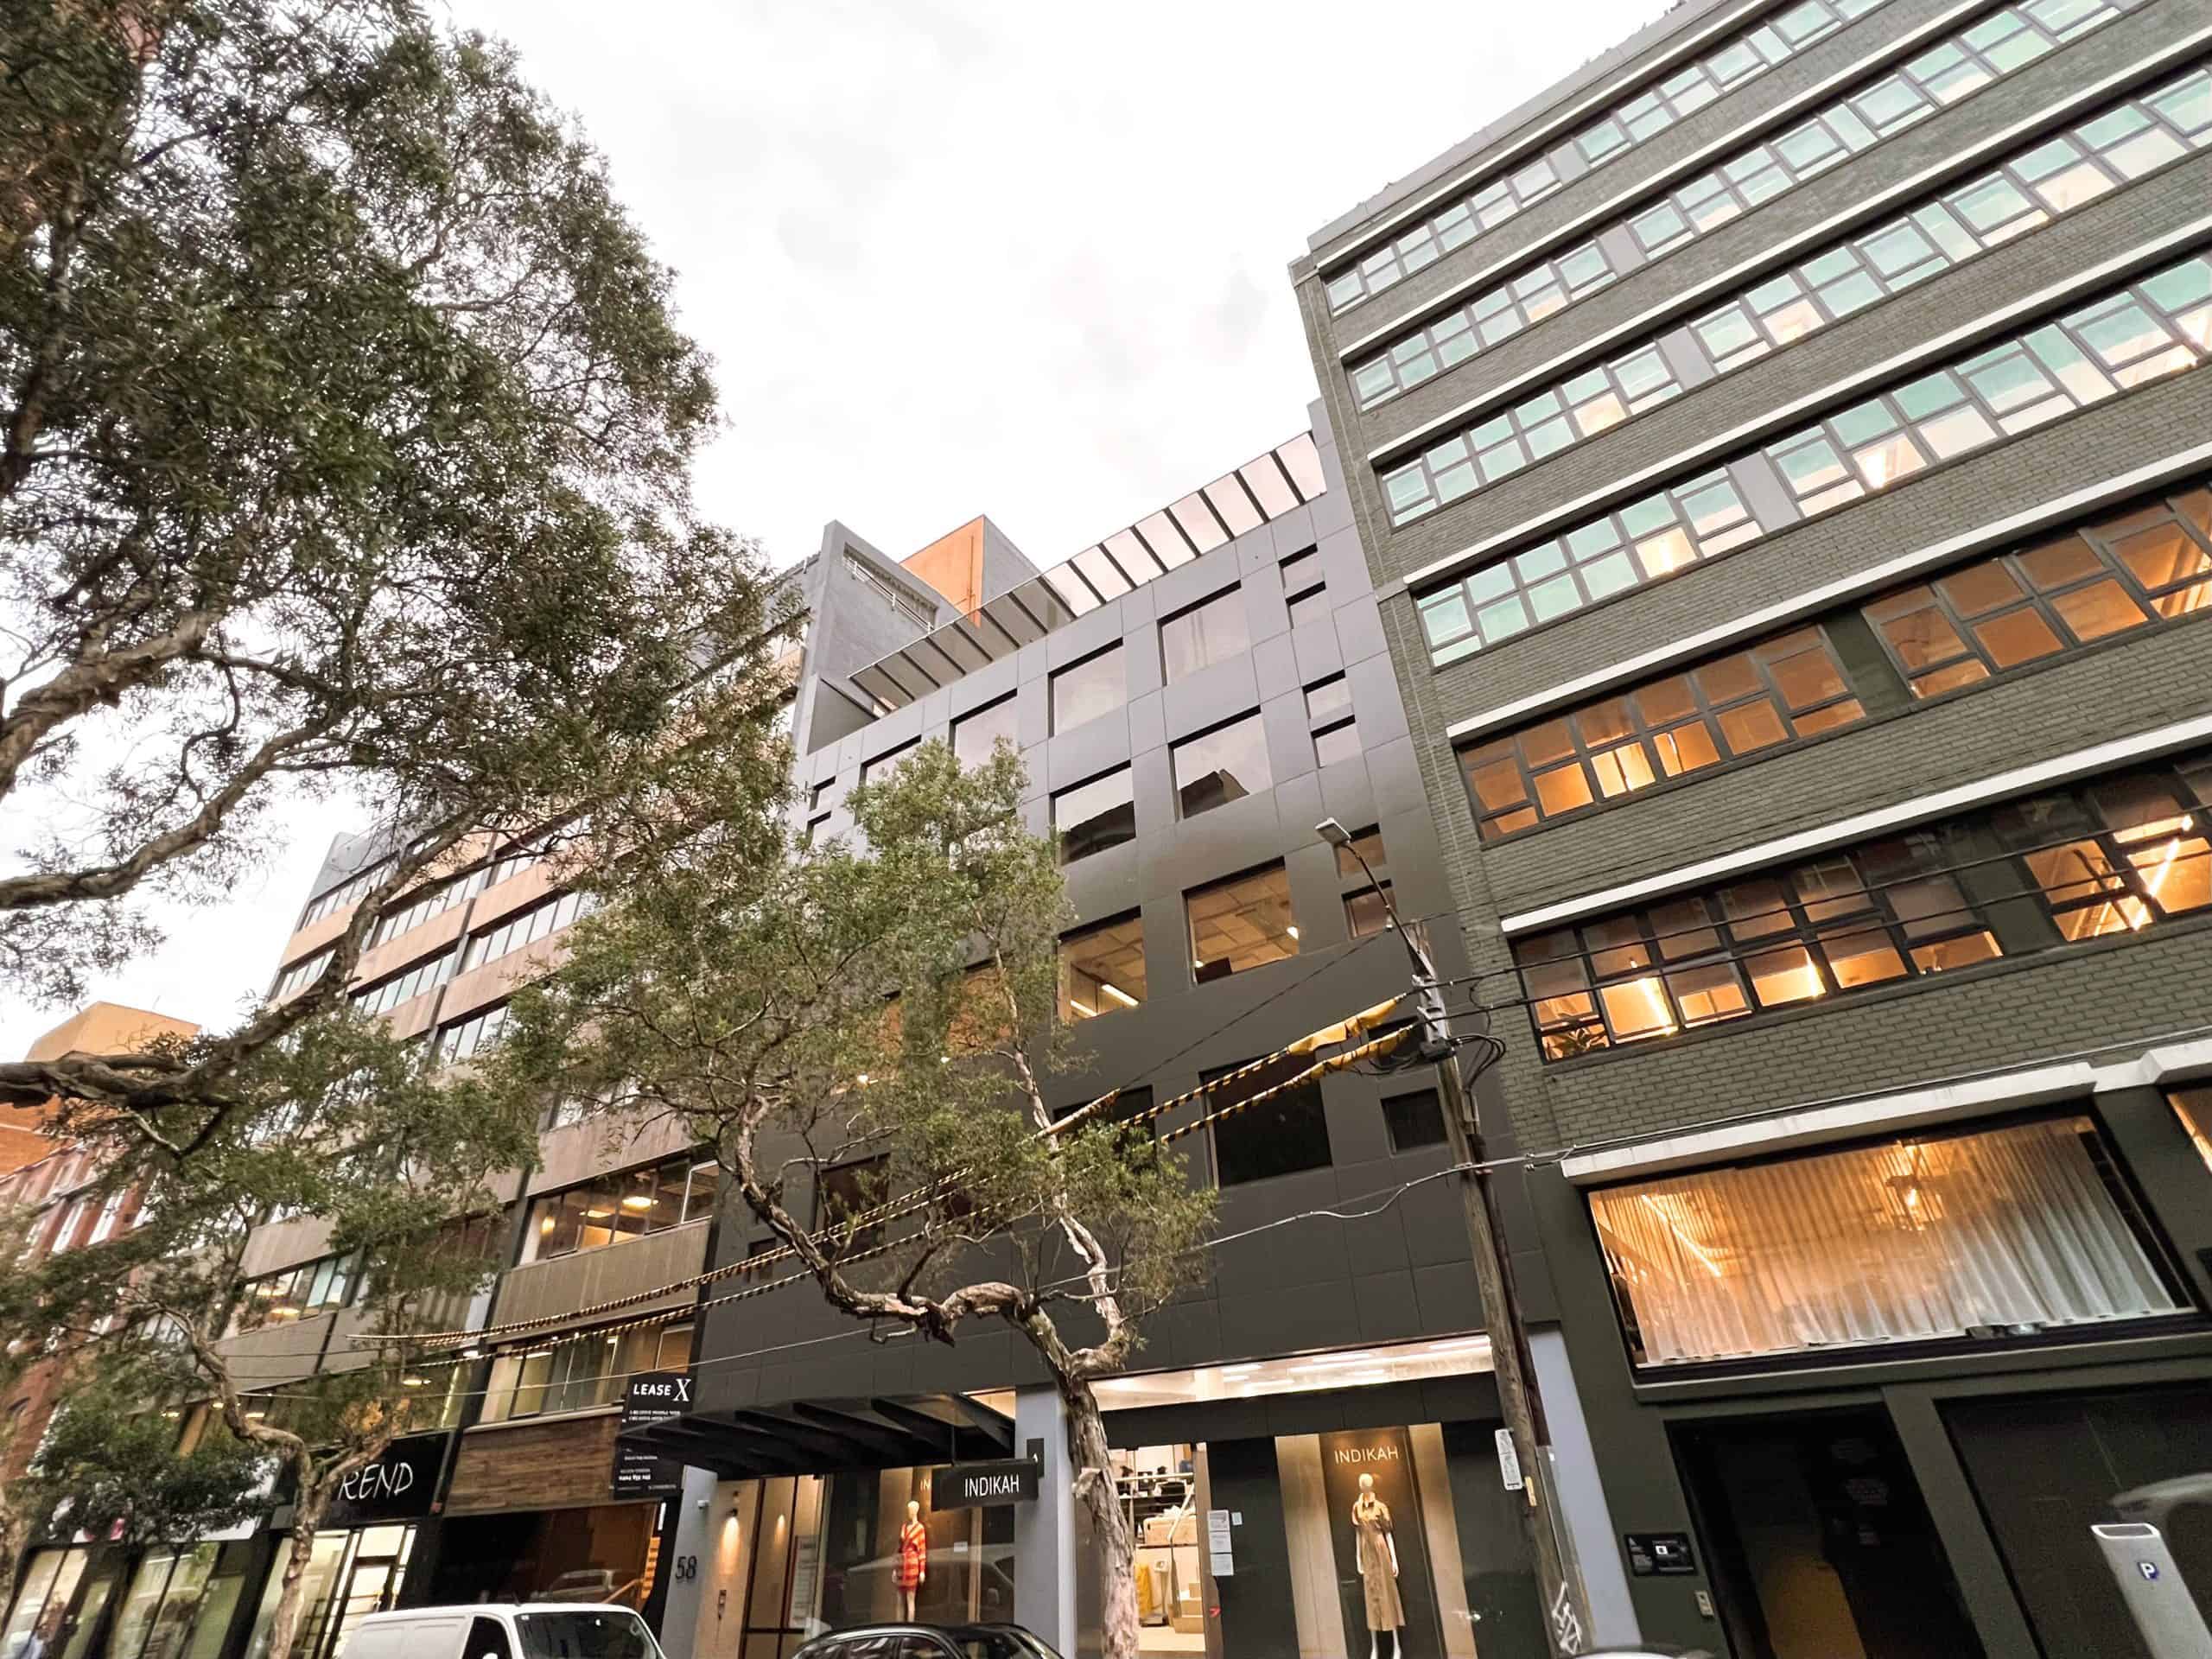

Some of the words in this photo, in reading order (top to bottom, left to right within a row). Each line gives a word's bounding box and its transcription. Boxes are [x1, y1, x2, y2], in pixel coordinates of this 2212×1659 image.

[633, 1383, 671, 1396] LEASE
[672, 1378, 692, 1402] X
[1334, 1446, 1398, 1464] INDIKAH
[964, 1475, 1020, 1497] INDIKAH
[676, 1555, 697, 1580] 58
[2140, 1562, 2155, 1579] P
